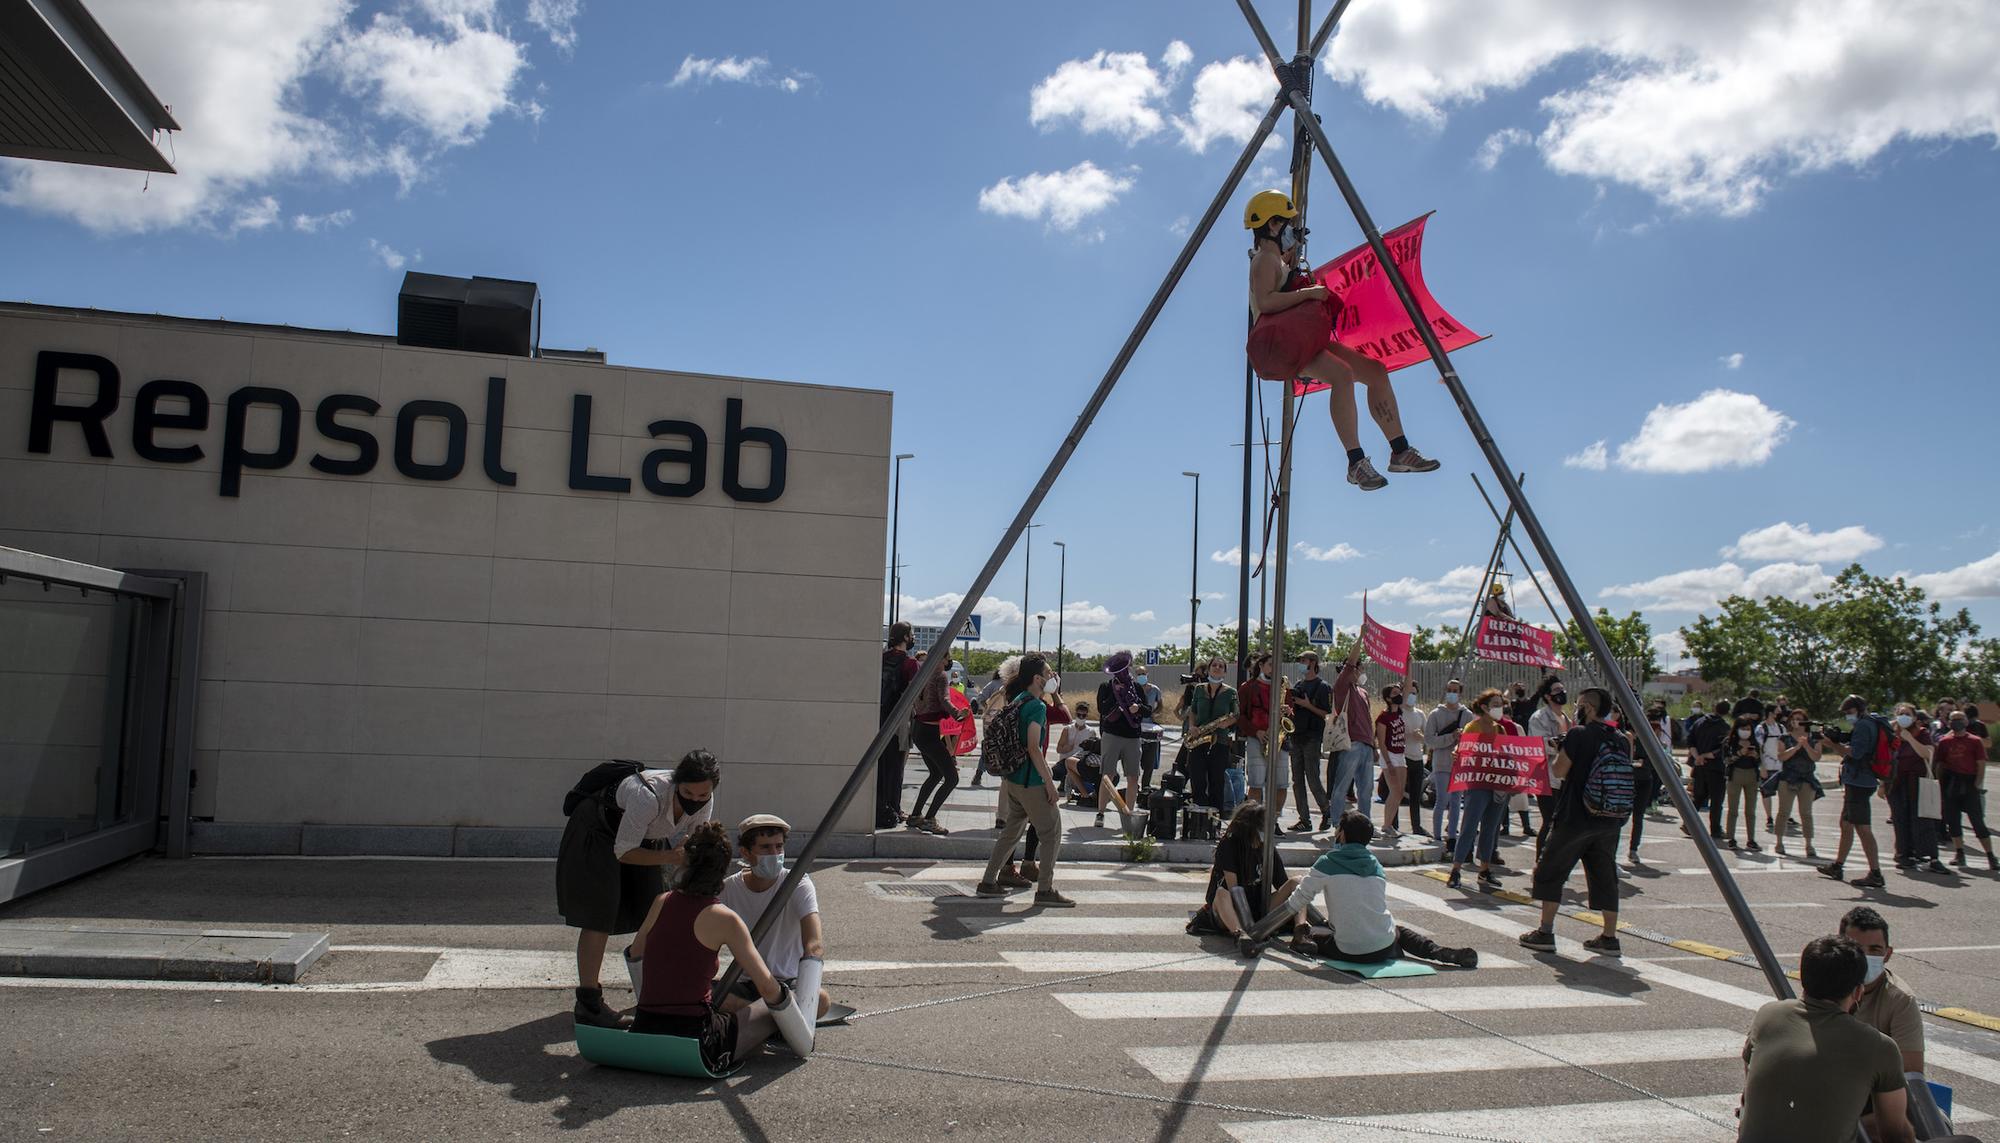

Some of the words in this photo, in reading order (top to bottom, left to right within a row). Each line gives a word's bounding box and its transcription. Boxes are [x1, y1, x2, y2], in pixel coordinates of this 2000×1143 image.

[27, 350, 517, 498] Repsol
[569, 393, 787, 503] Lab
[1149, 650, 1156, 664] P
[1502, 743, 1545, 757] LÍDER
[1461, 756, 1477, 767] EN
[1481, 756, 1530, 772] FALSAS
[1454, 772, 1538, 788] SOLUCIONES
